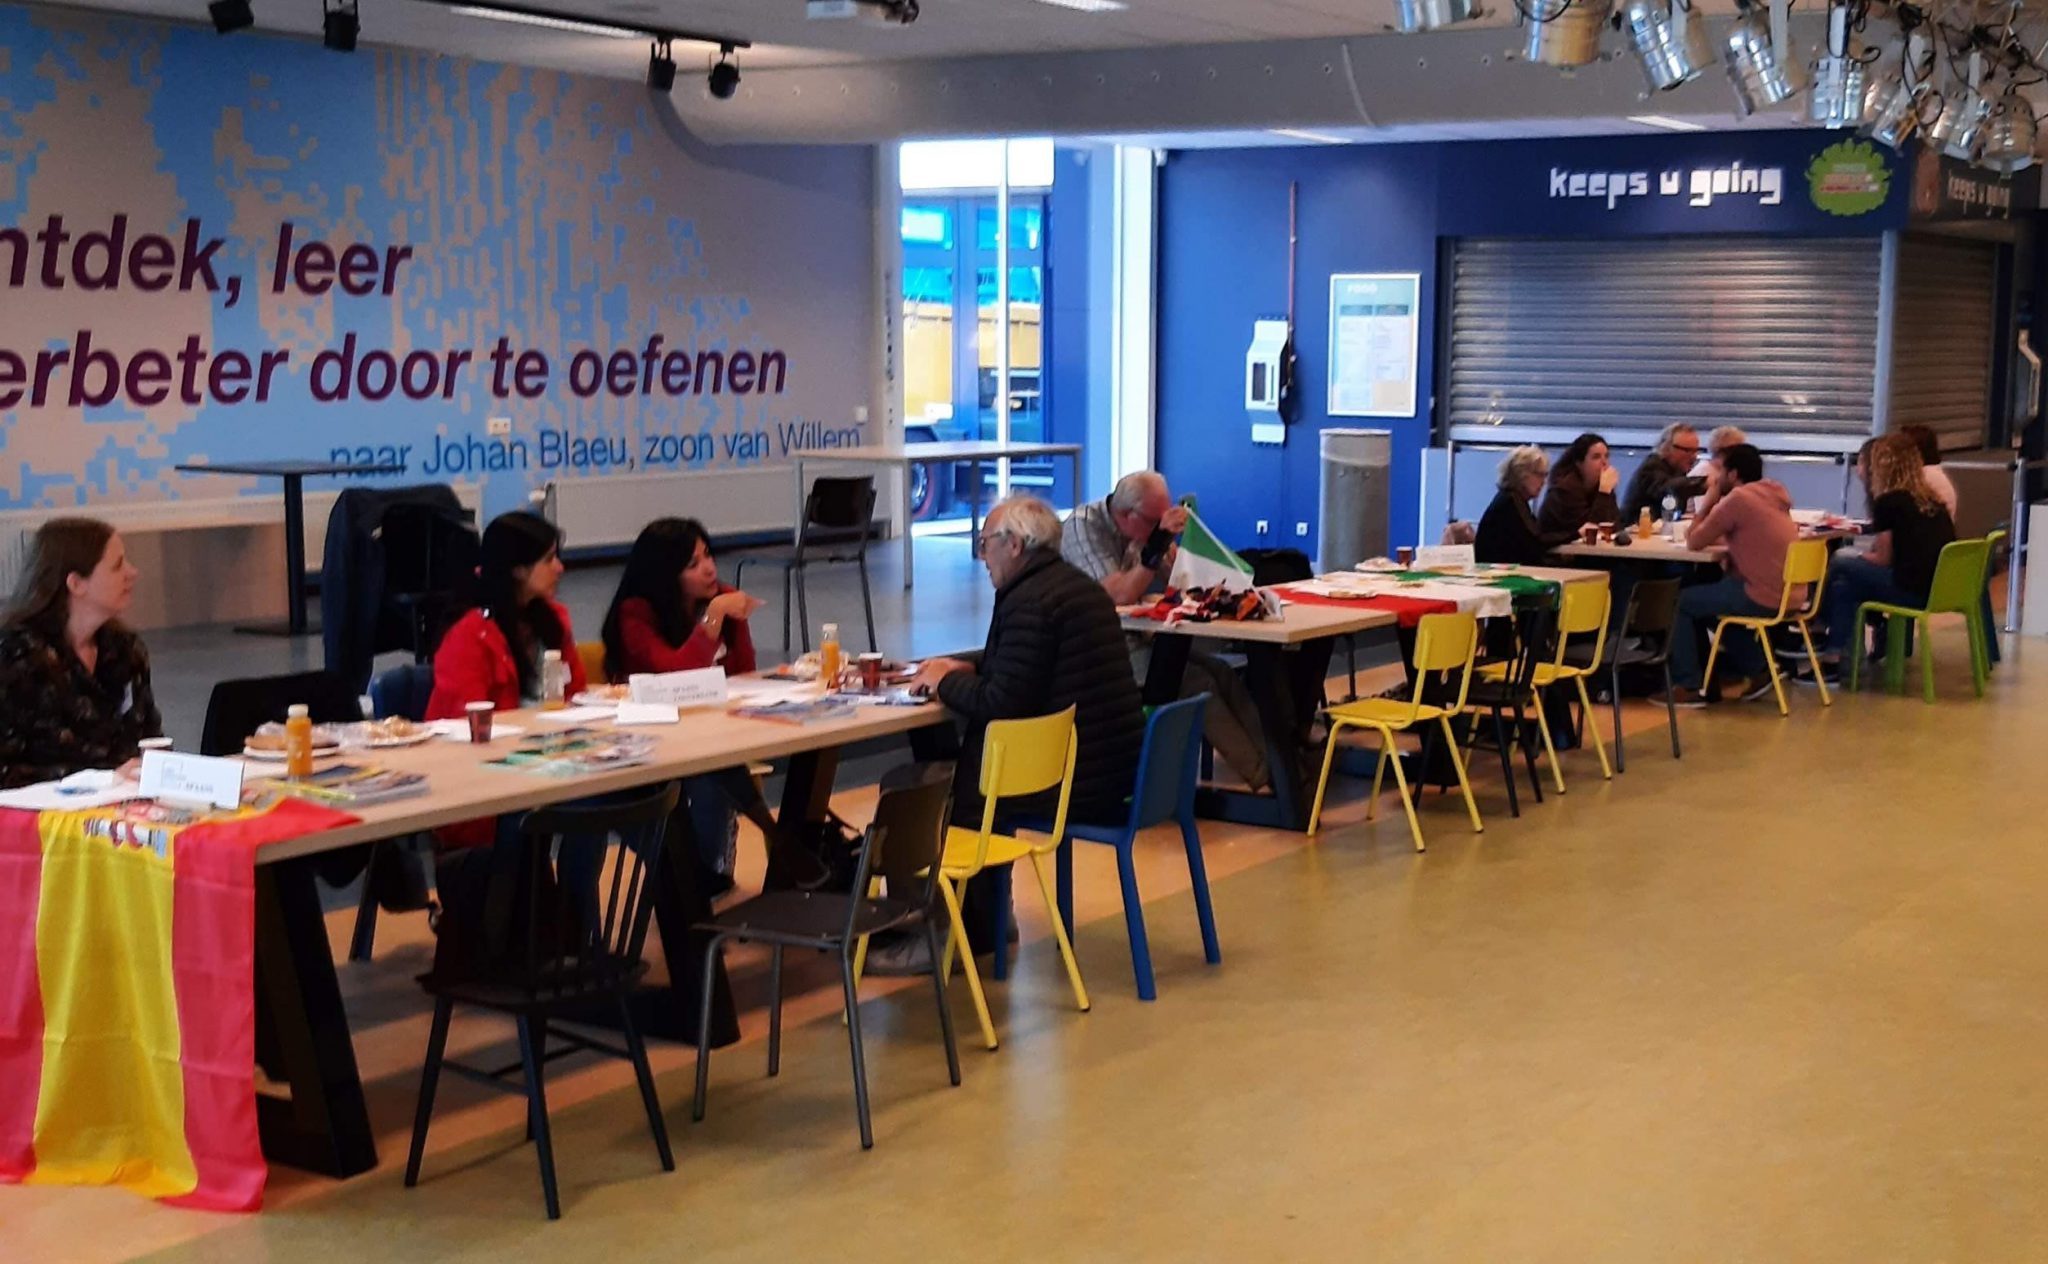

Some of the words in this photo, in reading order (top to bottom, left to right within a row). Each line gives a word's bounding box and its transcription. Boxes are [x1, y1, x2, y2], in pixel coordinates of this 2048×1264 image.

[1549, 167, 1648, 210] keeps
[1659, 169, 1680, 195] u
[1689, 161, 1782, 206] going
[272, 222, 412, 296] leer
[309, 331, 472, 401] door
[490, 336, 549, 398] te
[569, 333, 787, 397] oefenen
[423, 432, 528, 475] Johan
[540, 430, 635, 470] Blaeu,
[645, 434, 715, 463] zoon
[722, 431, 770, 459] van
[778, 421, 860, 455] Willem
